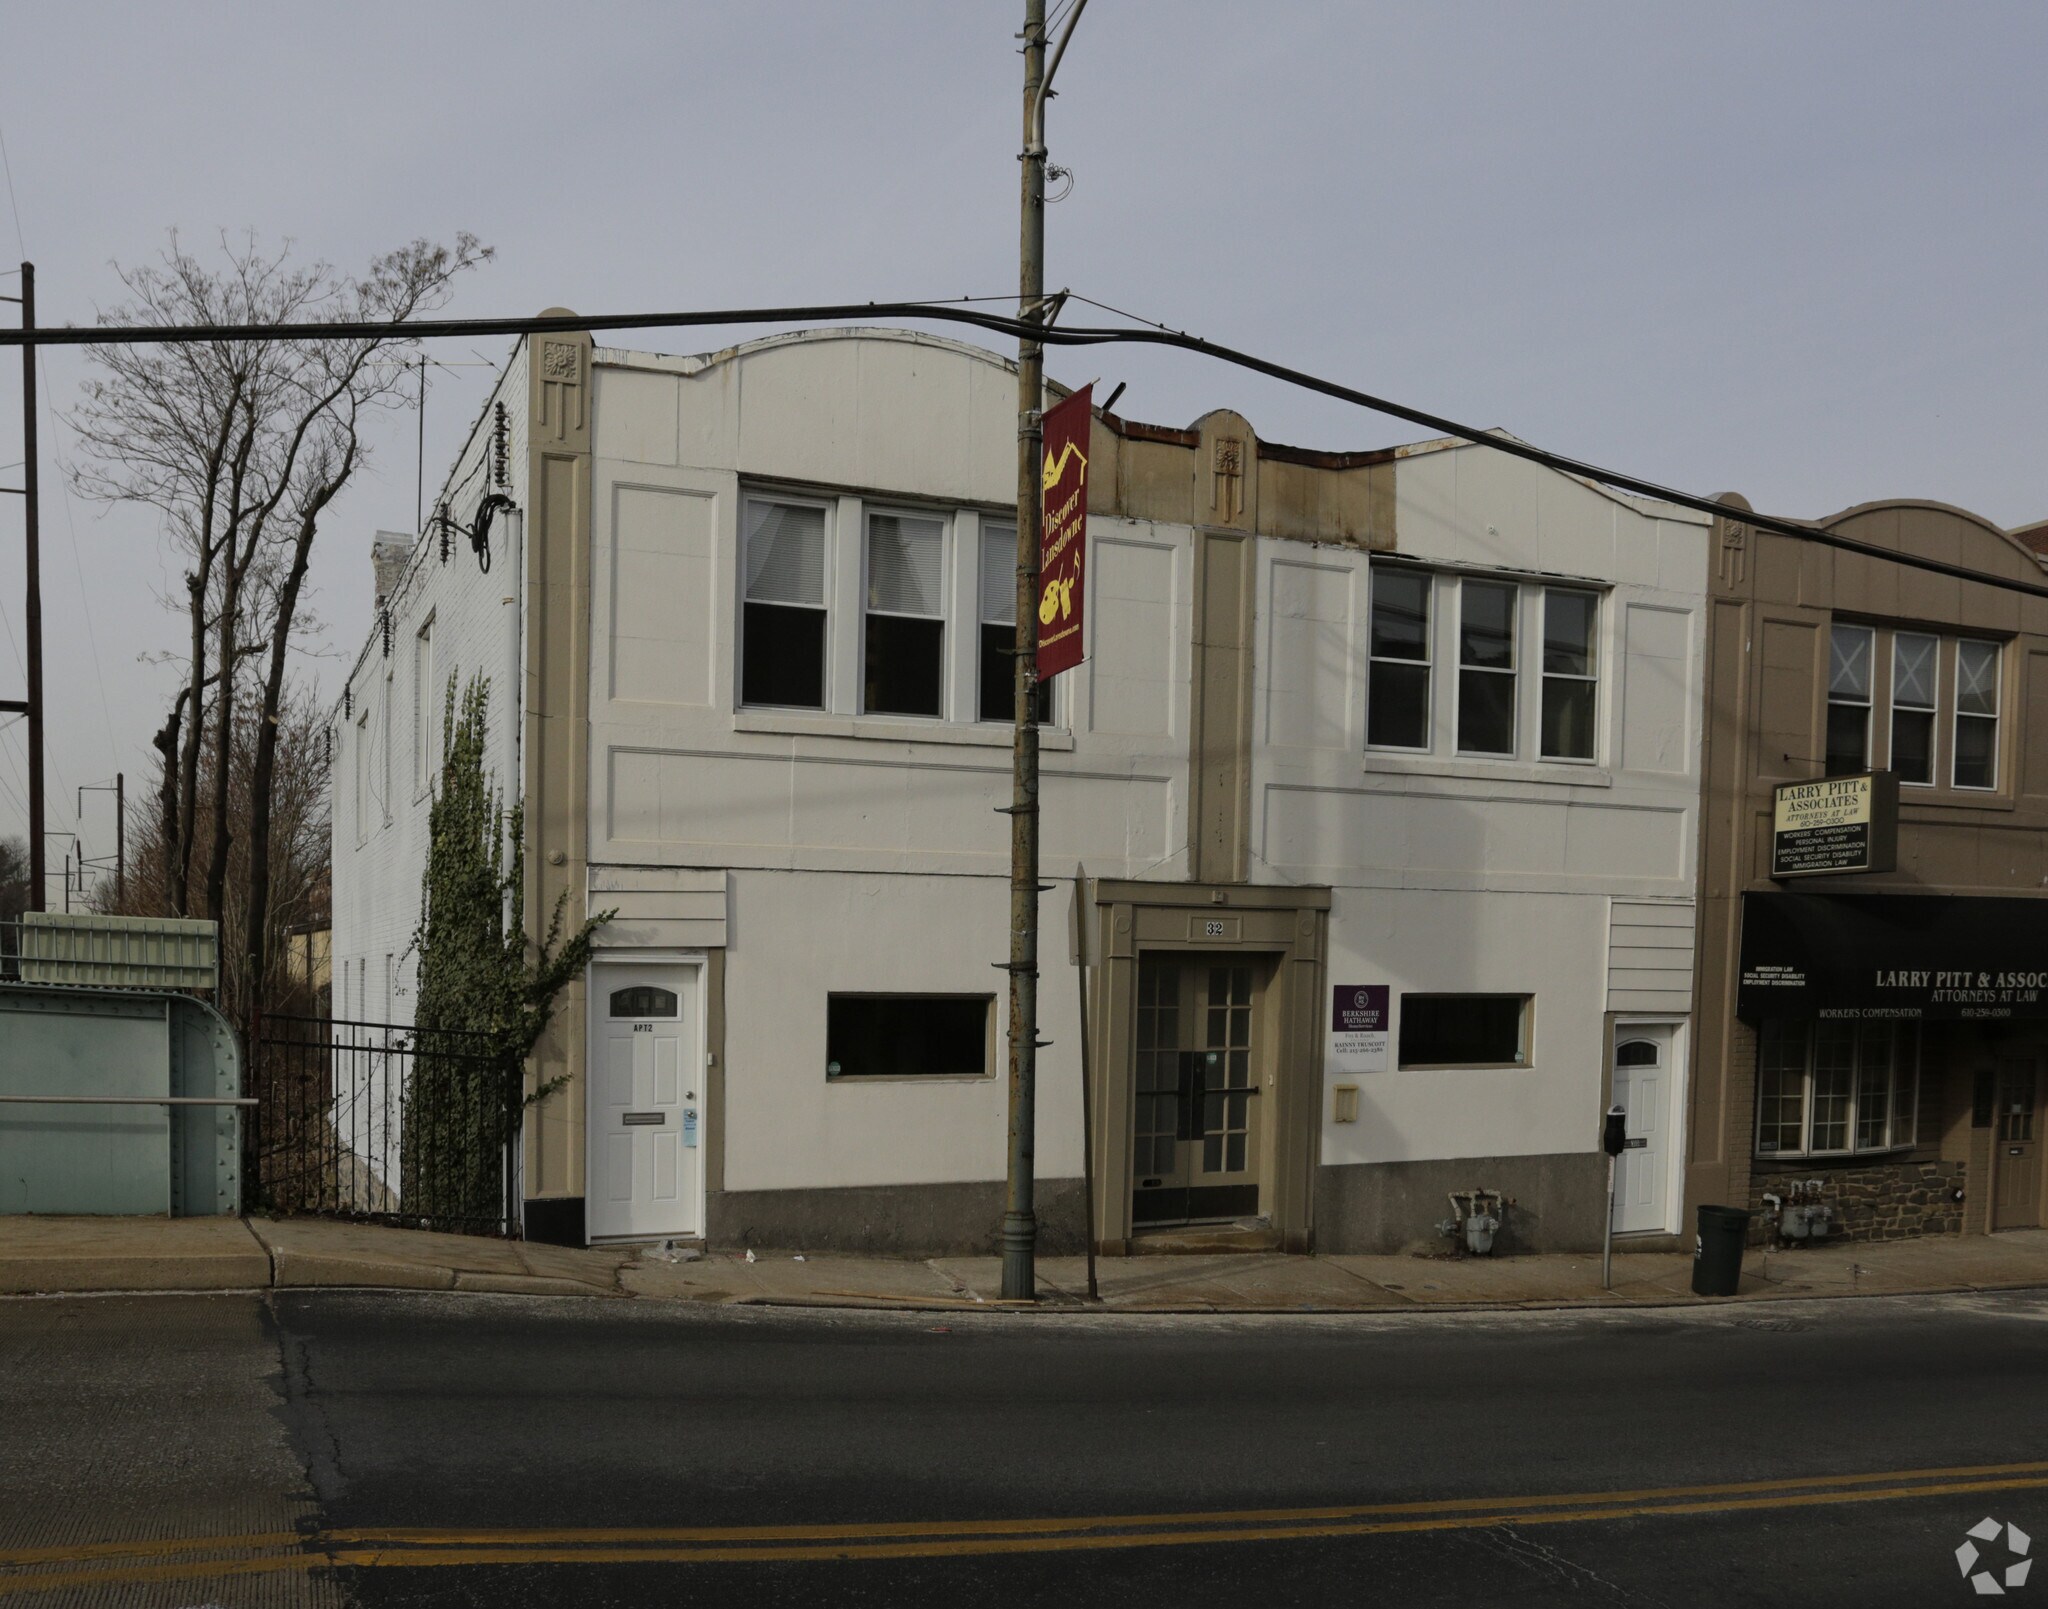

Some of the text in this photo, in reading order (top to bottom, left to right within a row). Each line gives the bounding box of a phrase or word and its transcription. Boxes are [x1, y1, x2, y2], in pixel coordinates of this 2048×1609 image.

[1045, 488, 1080, 540] Discover
[1041, 513, 1083, 573] Lansdowne
[1779, 780, 1868, 802] LARRY PITT &
[1788, 794, 1859, 812] ASSOCIATES
[1786, 807, 1860, 822] ATTORNEYS AT LAW
[1799, 817, 1845, 828] 610-259-0300
[1815, 825, 1862, 836] COMPENSATION
[1795, 835, 1848, 846] PERSONAL INJURY
[1778, 841, 1866, 856] EMPLOYMENT DISCRIMINATION
[1780, 850, 1862, 863] SOCIAL SECURITY DISABILITY
[1792, 860, 1832, 869] IMMIGRATION
[1207, 922, 1223, 935] 32
[1876, 970, 1931, 987] LARRY
[1936, 972, 1973, 988] PITT
[1977, 972, 1990, 988] &
[1931, 990, 2039, 1002] ATTORNEYS AT LAW
[1819, 1008, 1922, 1018] WORKER'S COMPENSATION
